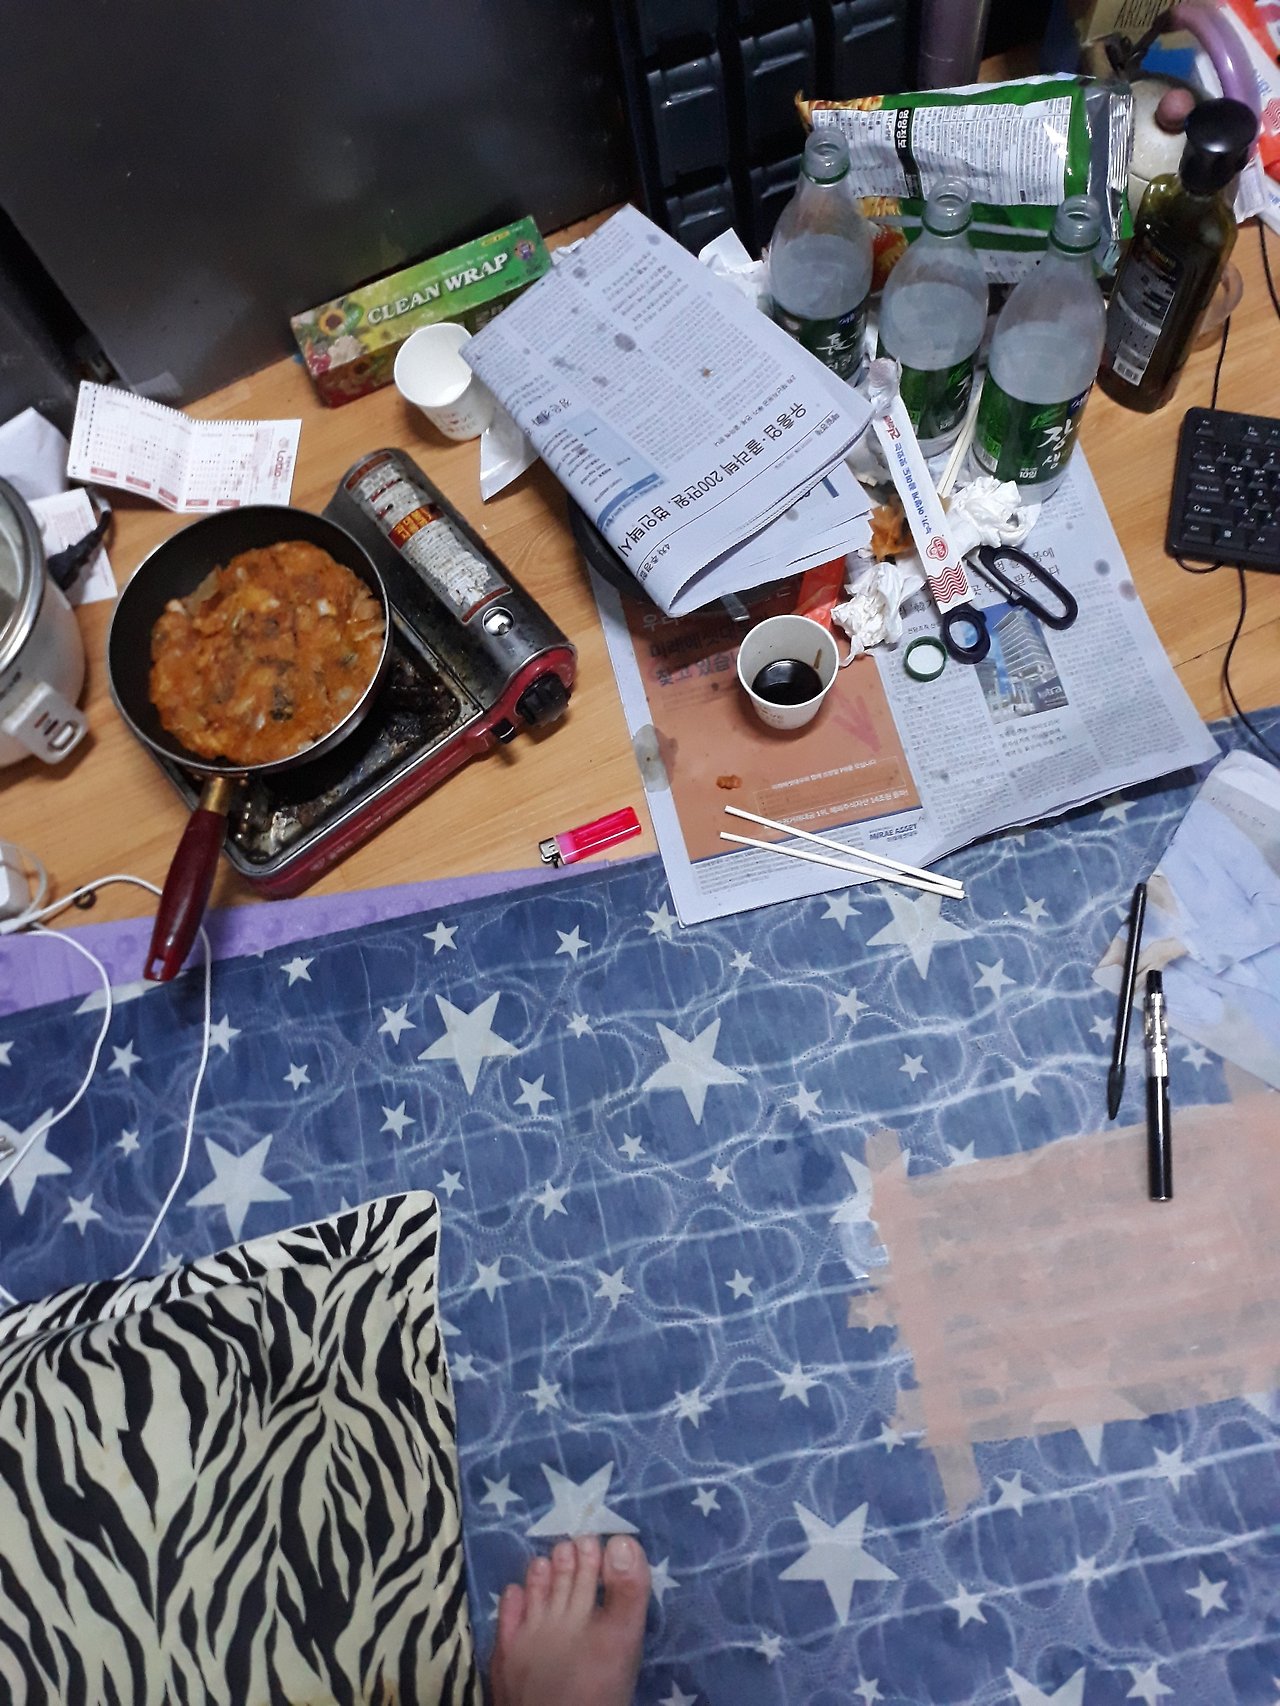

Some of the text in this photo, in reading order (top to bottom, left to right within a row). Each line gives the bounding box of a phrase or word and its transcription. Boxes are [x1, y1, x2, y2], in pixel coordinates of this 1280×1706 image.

[897, 110, 909, 147] 영양정보
[366, 283, 440, 325] CLEAN
[444, 252, 509, 293] WRAP
[719, 401, 808, 479] 유흥업·콜라텍
[616, 503, 669, 559] 법인택시
[656, 542, 671, 556] 4차
[1014, 564, 1060, 586] 팔걷다
[696, 650, 736, 677] 있습
[869, 823, 917, 839] MIRAE ASSET
